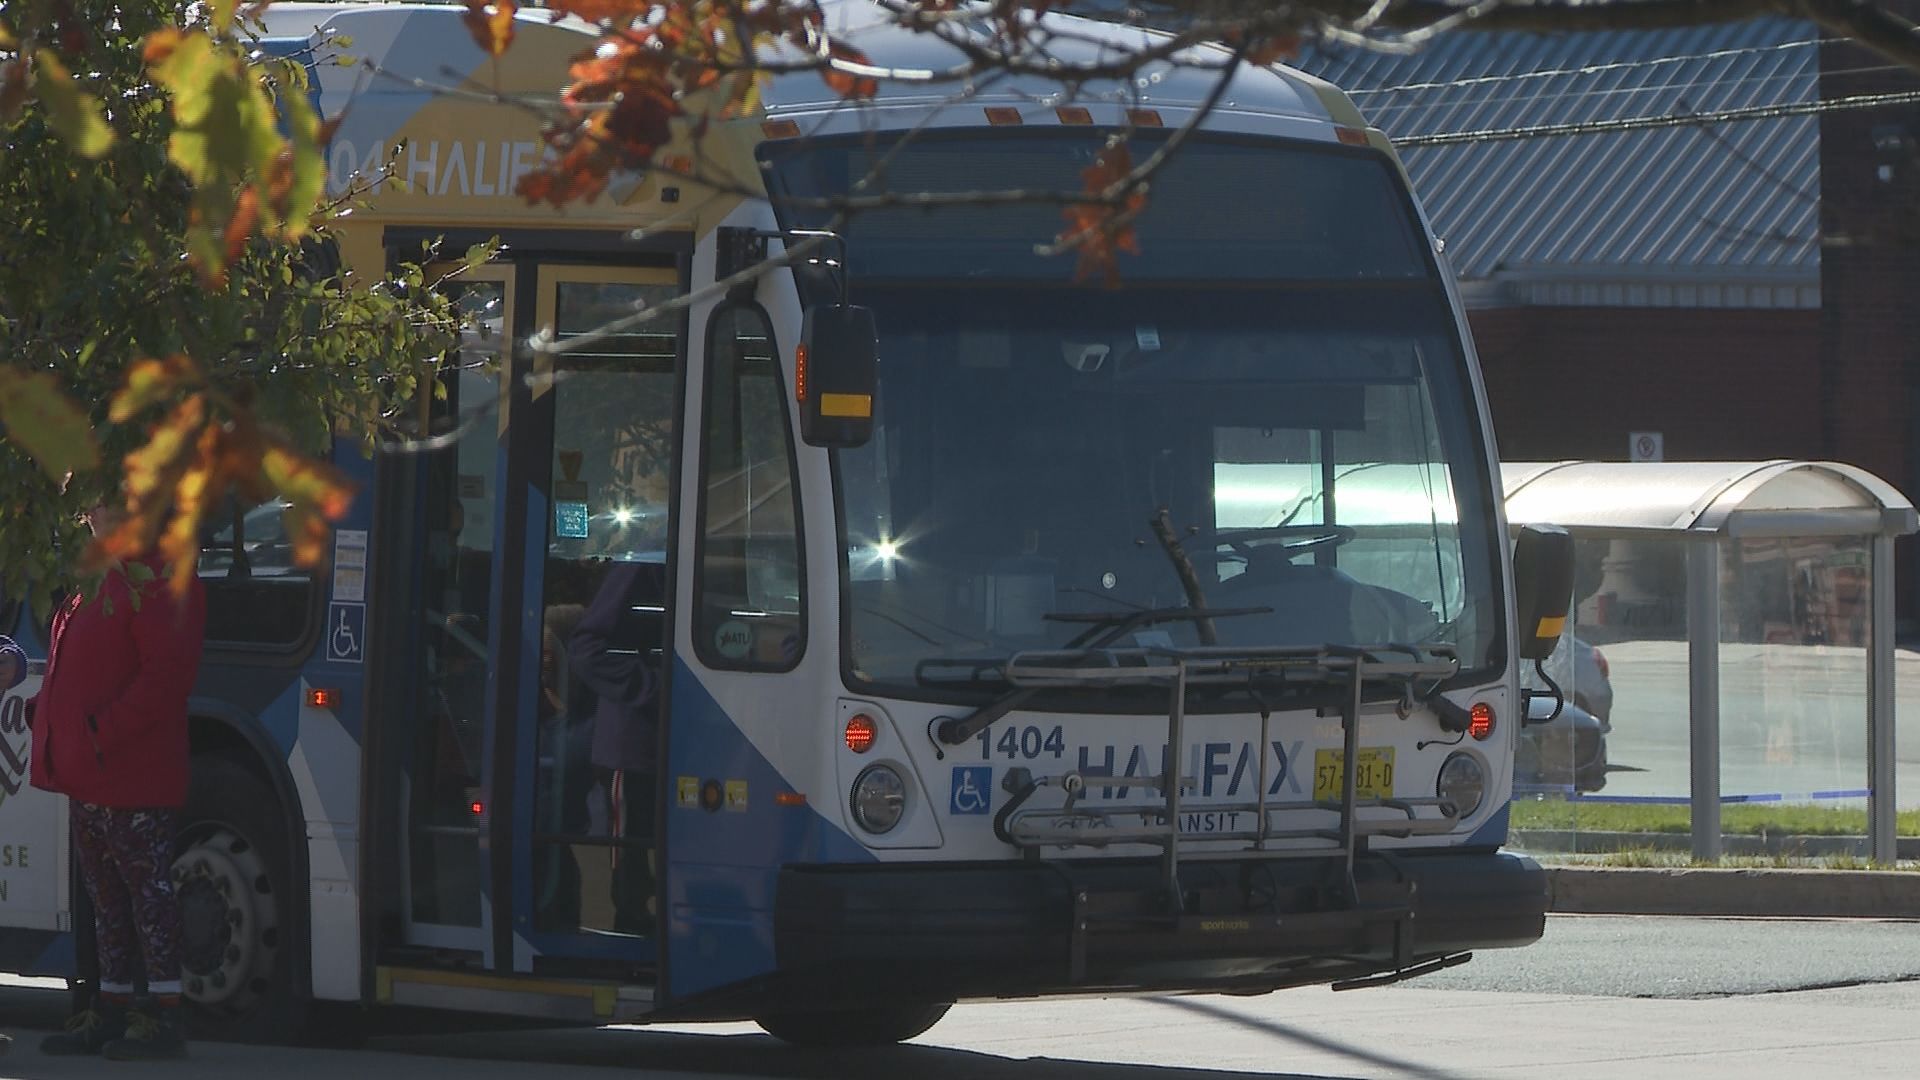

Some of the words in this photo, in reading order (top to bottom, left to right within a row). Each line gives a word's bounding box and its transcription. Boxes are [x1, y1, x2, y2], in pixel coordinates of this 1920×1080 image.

[405, 138, 560, 197] HALIF
[977, 725, 1065, 760] 1404
[1318, 763, 1392, 791] 57-81-D
[1140, 811, 1240, 833] NSIT
